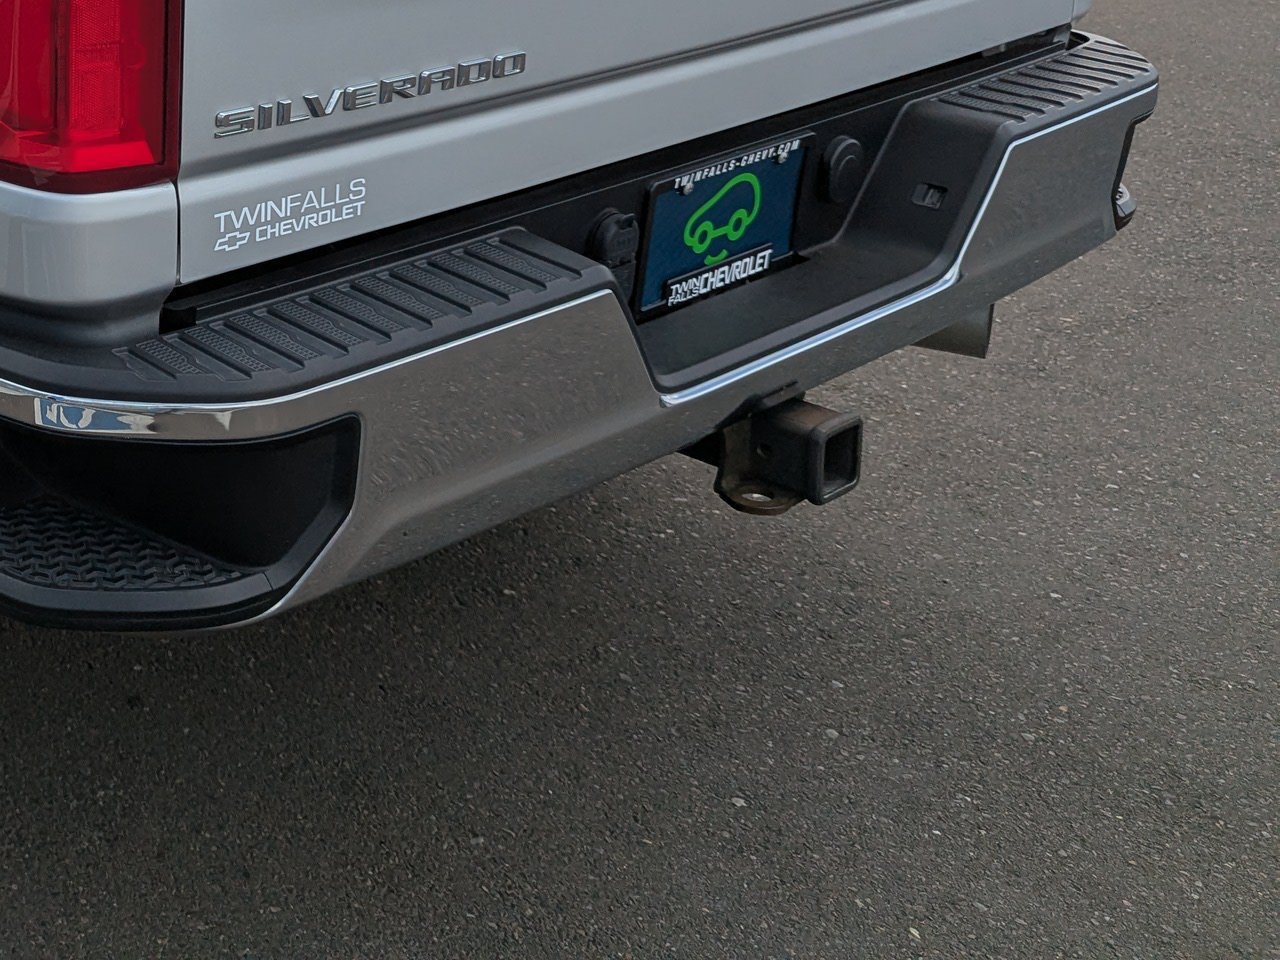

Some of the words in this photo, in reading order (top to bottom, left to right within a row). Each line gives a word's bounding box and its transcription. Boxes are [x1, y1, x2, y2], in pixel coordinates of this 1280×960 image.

[214, 51, 527, 139] SILVERADO
[214, 178, 367, 233] TWINFALLS
[255, 201, 367, 243] CHEVROLET
[670, 276, 701, 297] TWIN
[699, 248, 774, 295] CHEVROLET
[667, 286, 701, 307] FALLS
